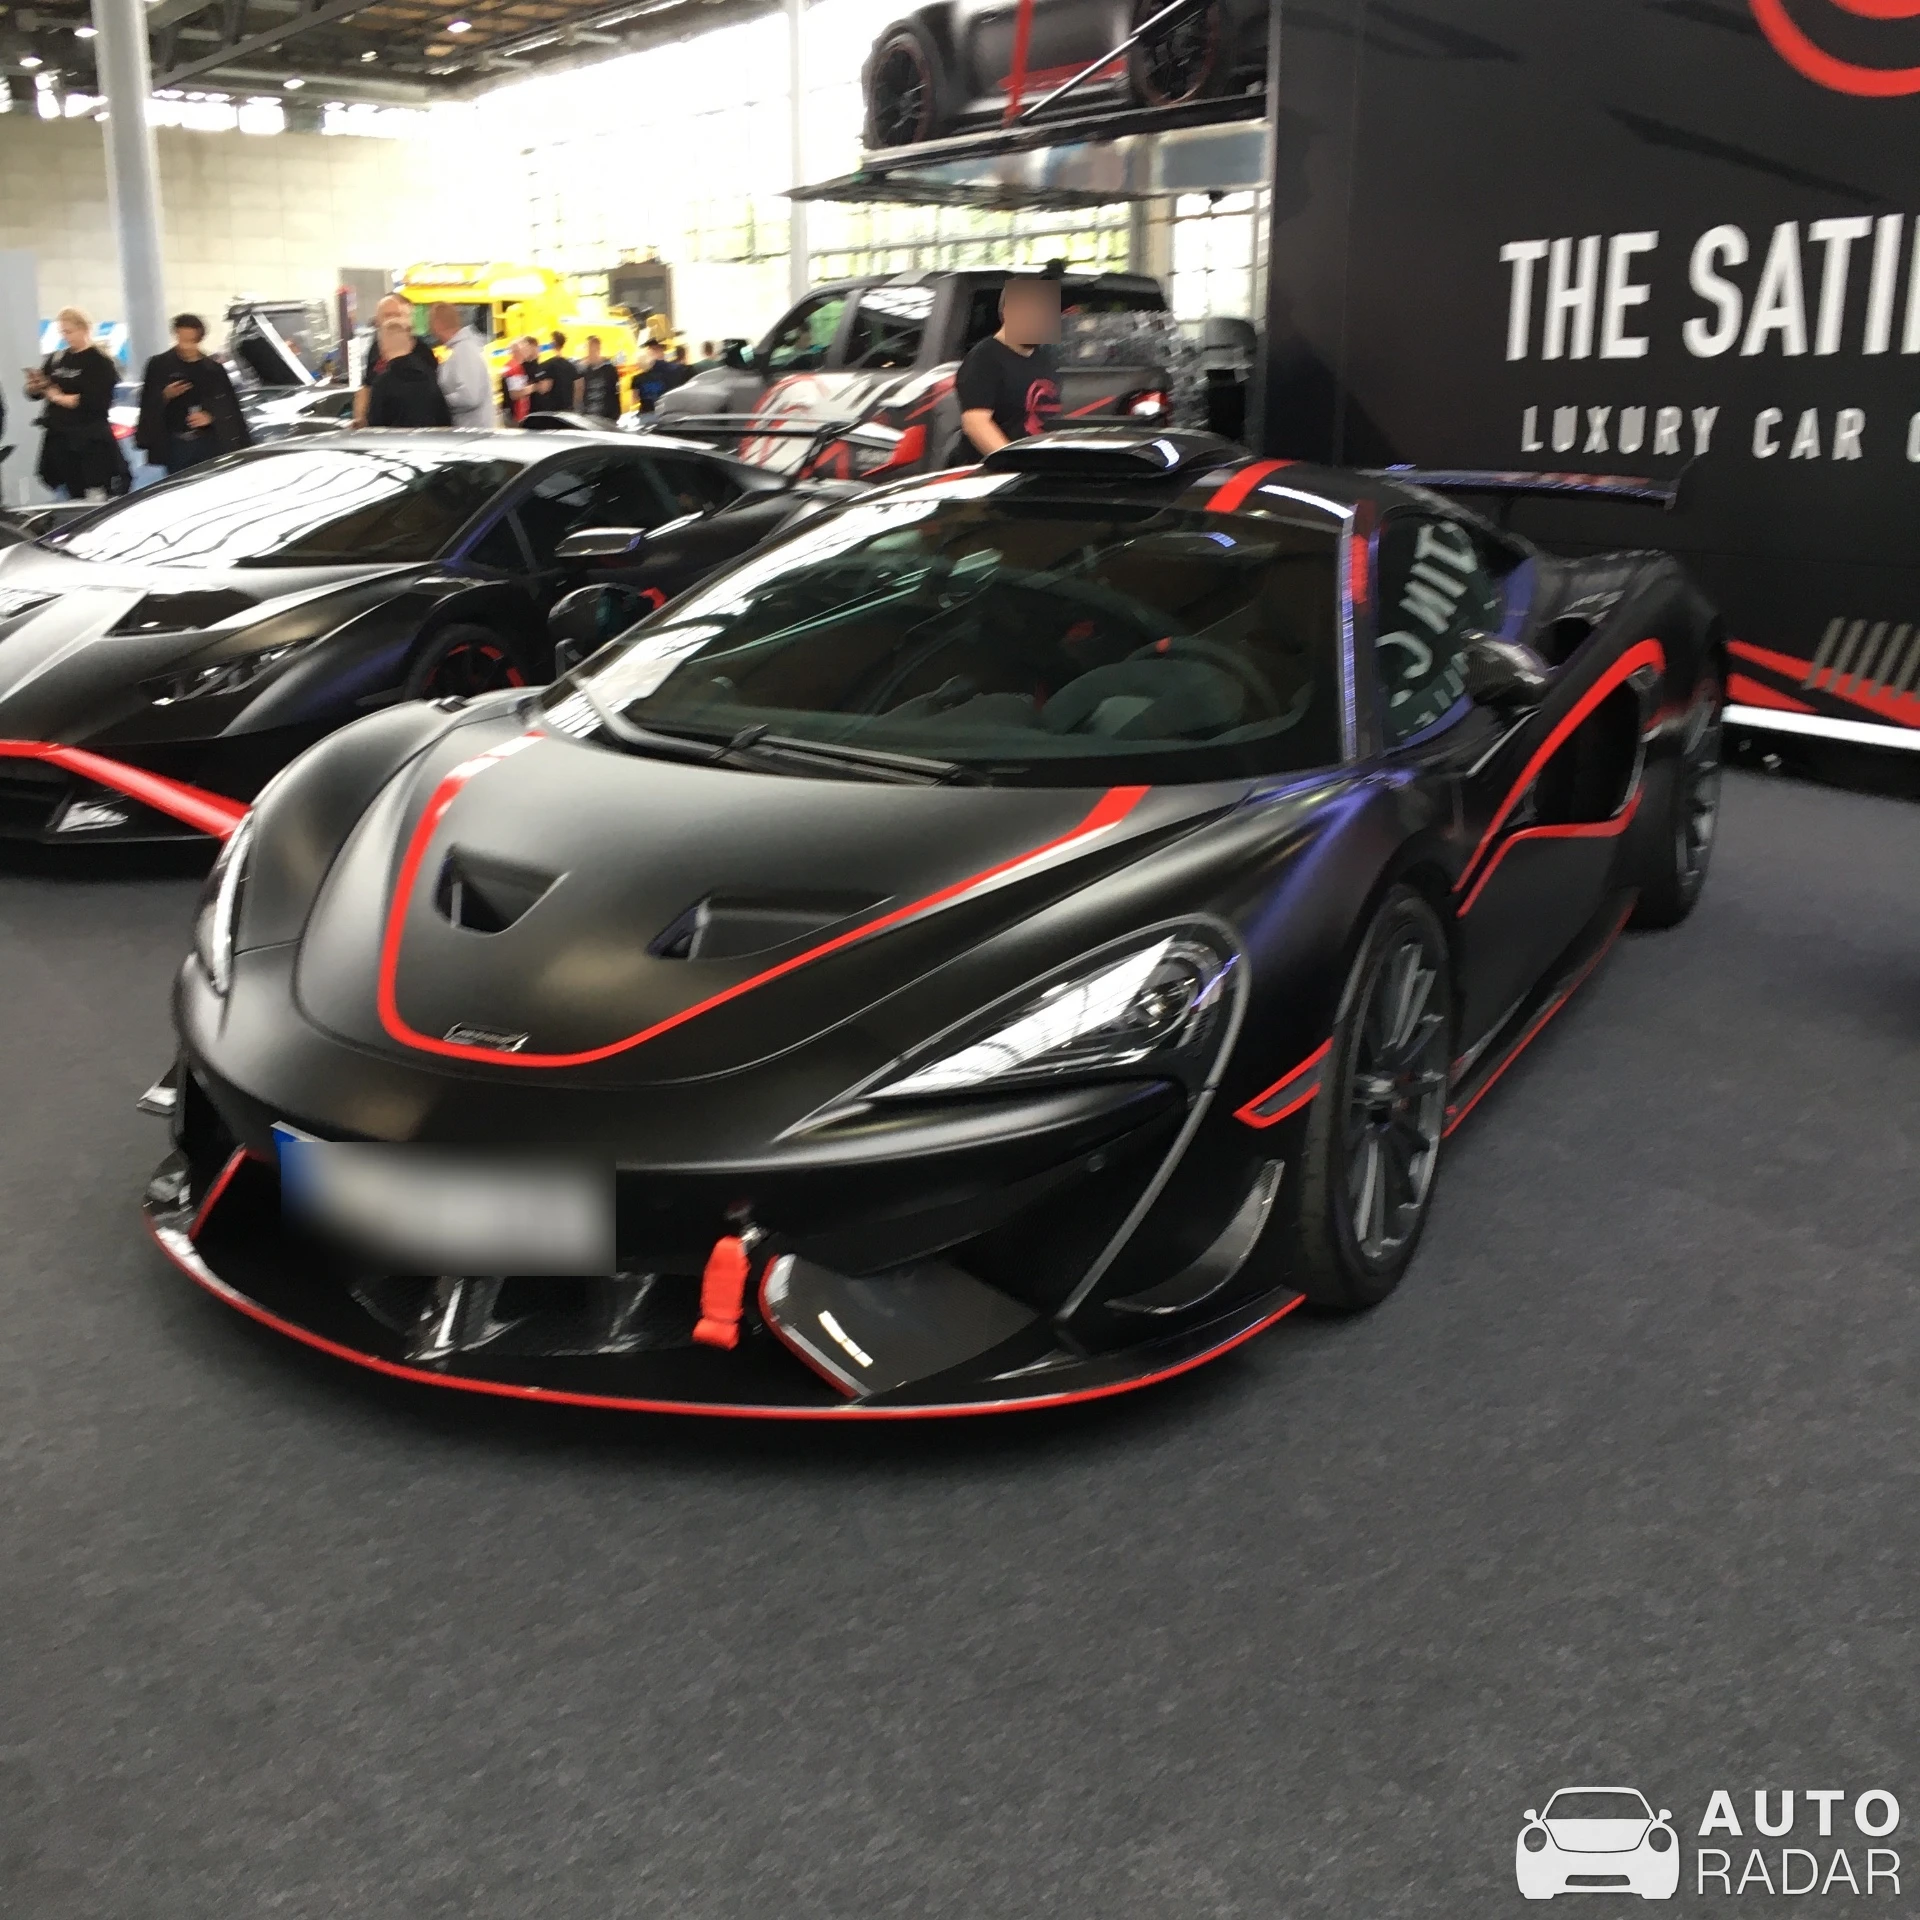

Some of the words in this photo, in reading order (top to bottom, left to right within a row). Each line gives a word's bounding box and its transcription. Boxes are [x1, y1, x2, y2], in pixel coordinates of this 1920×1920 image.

[1499, 230, 1660, 361] THE
[1520, 406, 1720, 456] LUXURY
[1751, 406, 1866, 461] CAR
